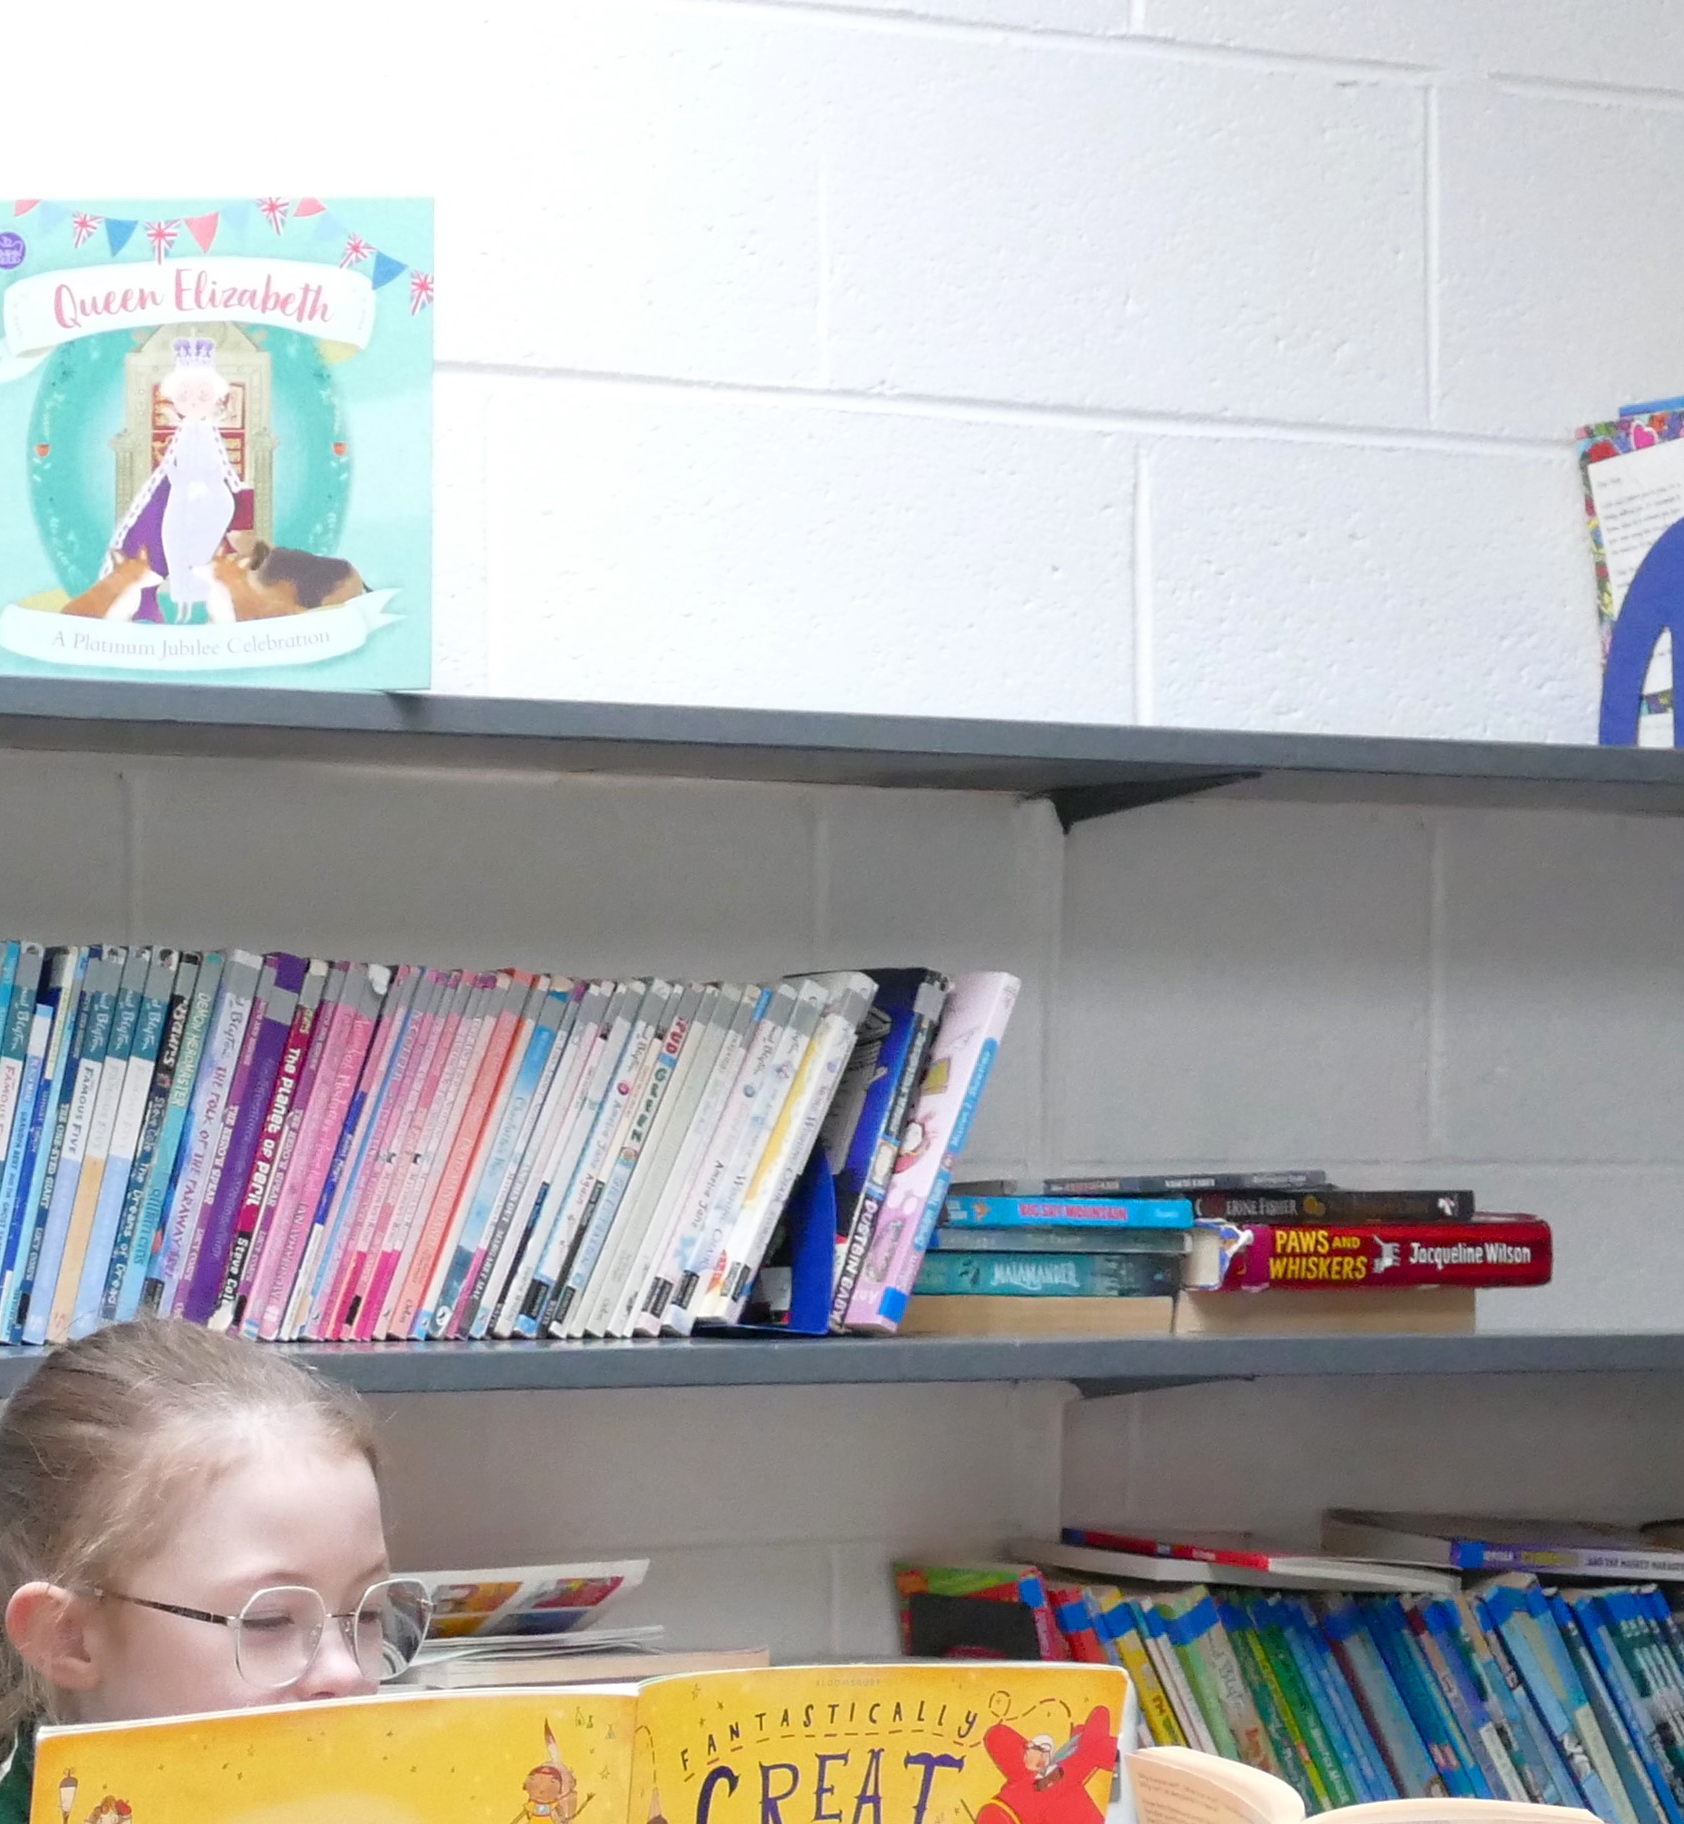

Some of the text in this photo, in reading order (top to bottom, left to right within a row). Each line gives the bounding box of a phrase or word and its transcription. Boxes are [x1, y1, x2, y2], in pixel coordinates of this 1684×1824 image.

[53, 267, 334, 330] Queen Elizabeth
[51, 628, 331, 659] A Platinum Jubilee Celebration
[66, 1066, 96, 1154] FAMOUS FIVE
[845, 1198, 881, 1274] DUSTBIN
[1275, 1229, 1361, 1254] PAWS AND
[1410, 1241, 1532, 1265] Jacqueline Wilson
[1269, 1255, 1368, 1280] WHISKERS
[681, 1700, 979, 1772] FANTASTICALLY
